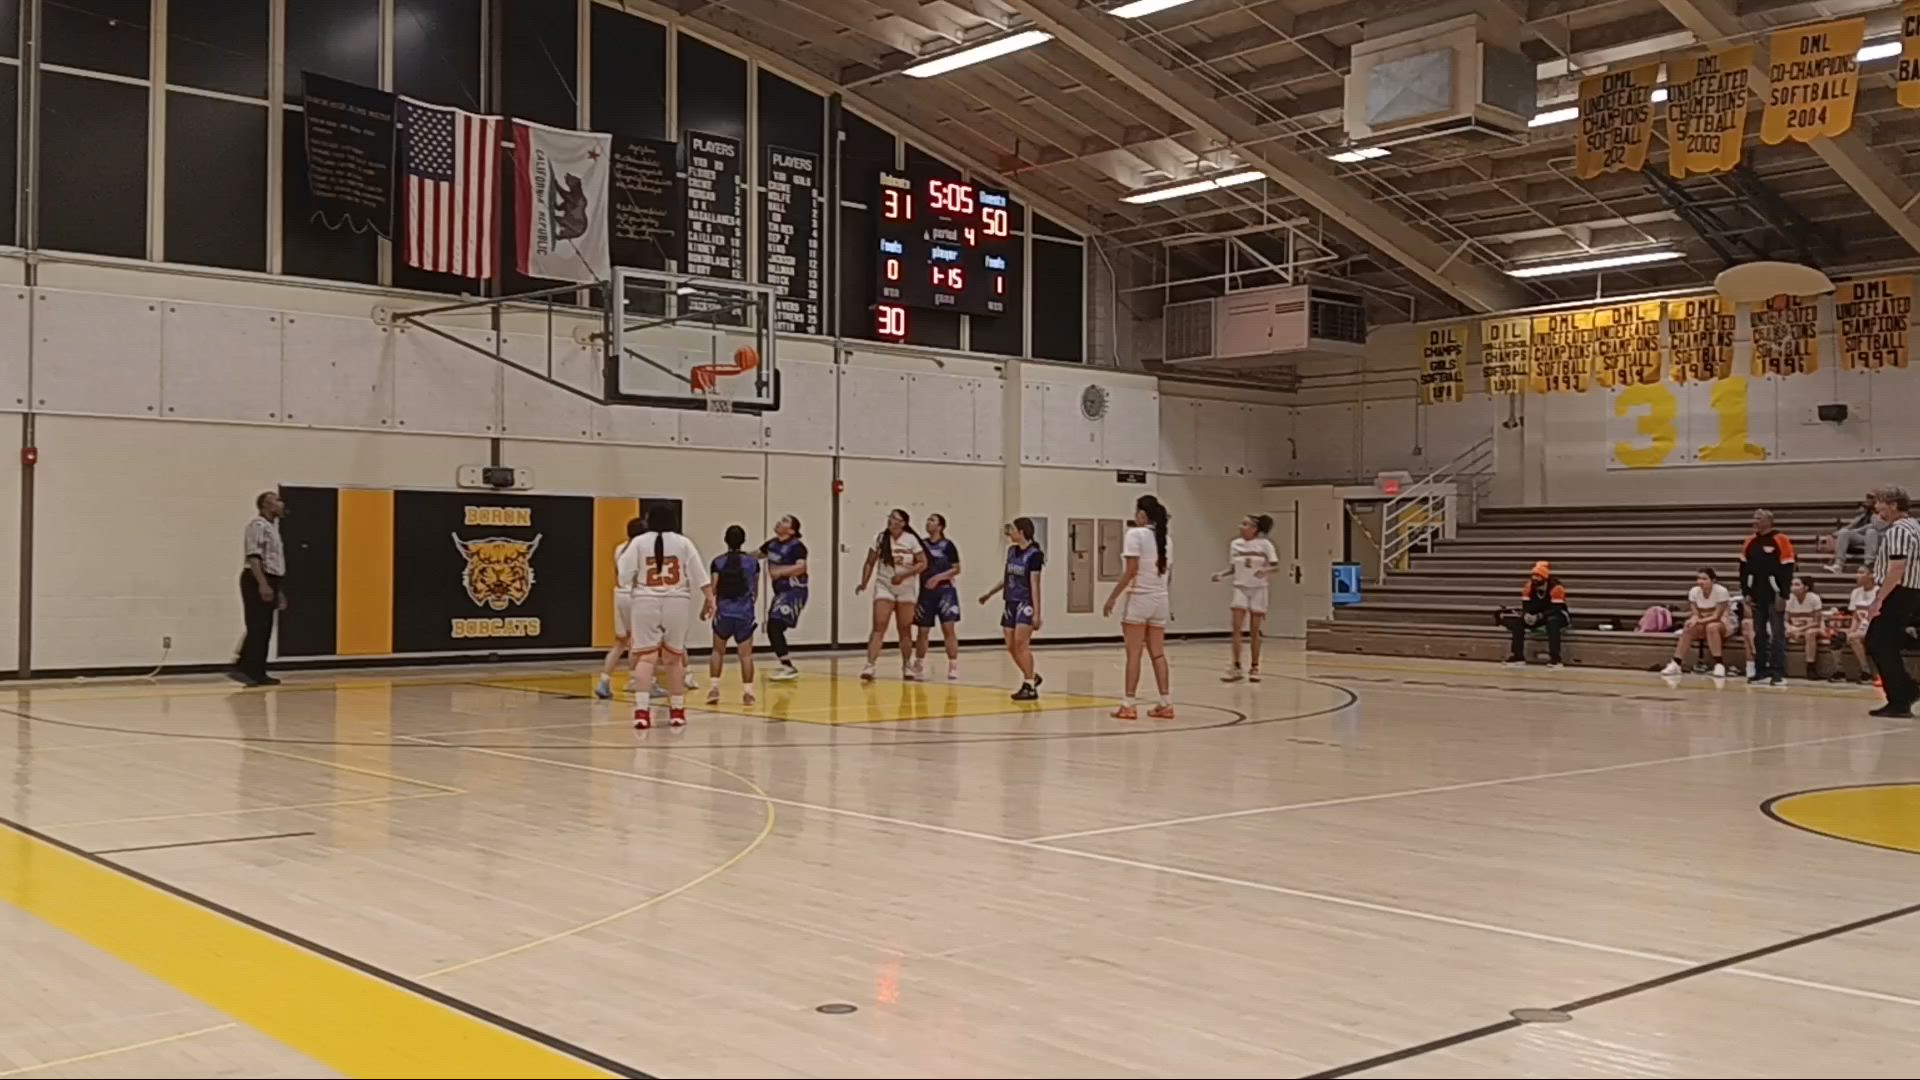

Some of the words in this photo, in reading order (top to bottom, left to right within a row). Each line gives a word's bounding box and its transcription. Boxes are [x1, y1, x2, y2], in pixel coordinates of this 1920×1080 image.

[1800, 34, 1831, 55] DML
[1770, 54, 1857, 83] CO-CHAMPIONS
[1603, 72, 1632, 92] DML
[1771, 78, 1849, 106] SOFTBALL
[1787, 106, 1827, 128] 2004
[693, 138, 735, 157] PLAYERS
[1687, 134, 1720, 153] 2003
[773, 153, 812, 171] PLAYERS
[885, 190, 912, 219] 31
[930, 180, 974, 214] 5:05
[982, 207, 1007, 236] 50
[964, 227, 975, 246] 4
[887, 259, 899, 280] 0
[996, 276, 1003, 294] 1
[1853, 281, 1893, 300] DML
[1612, 306, 1645, 324] DML
[1686, 300, 1720, 317] DML
[1836, 297, 1911, 320] UNDEFEATED
[878, 305, 905, 336] 30
[1550, 314, 1579, 331] DML
[1669, 314, 1736, 334] UNDEFEATED
[1842, 315, 1907, 336] CHAMPIONS
[1534, 344, 1592, 362] CHAMPIONS
[1845, 333, 1904, 353] SOFTBALL
[1485, 350, 1527, 364] CHAMPS
[1850, 350, 1899, 368] 1997
[1483, 365, 1529, 378] SOFTBALL
[1537, 360, 1588, 377] SOFTBALL
[1615, 376, 1766, 468] 31
[464, 506, 531, 526] BORON
[646, 555, 680, 587] 23
[451, 617, 541, 638] BOBCATS
